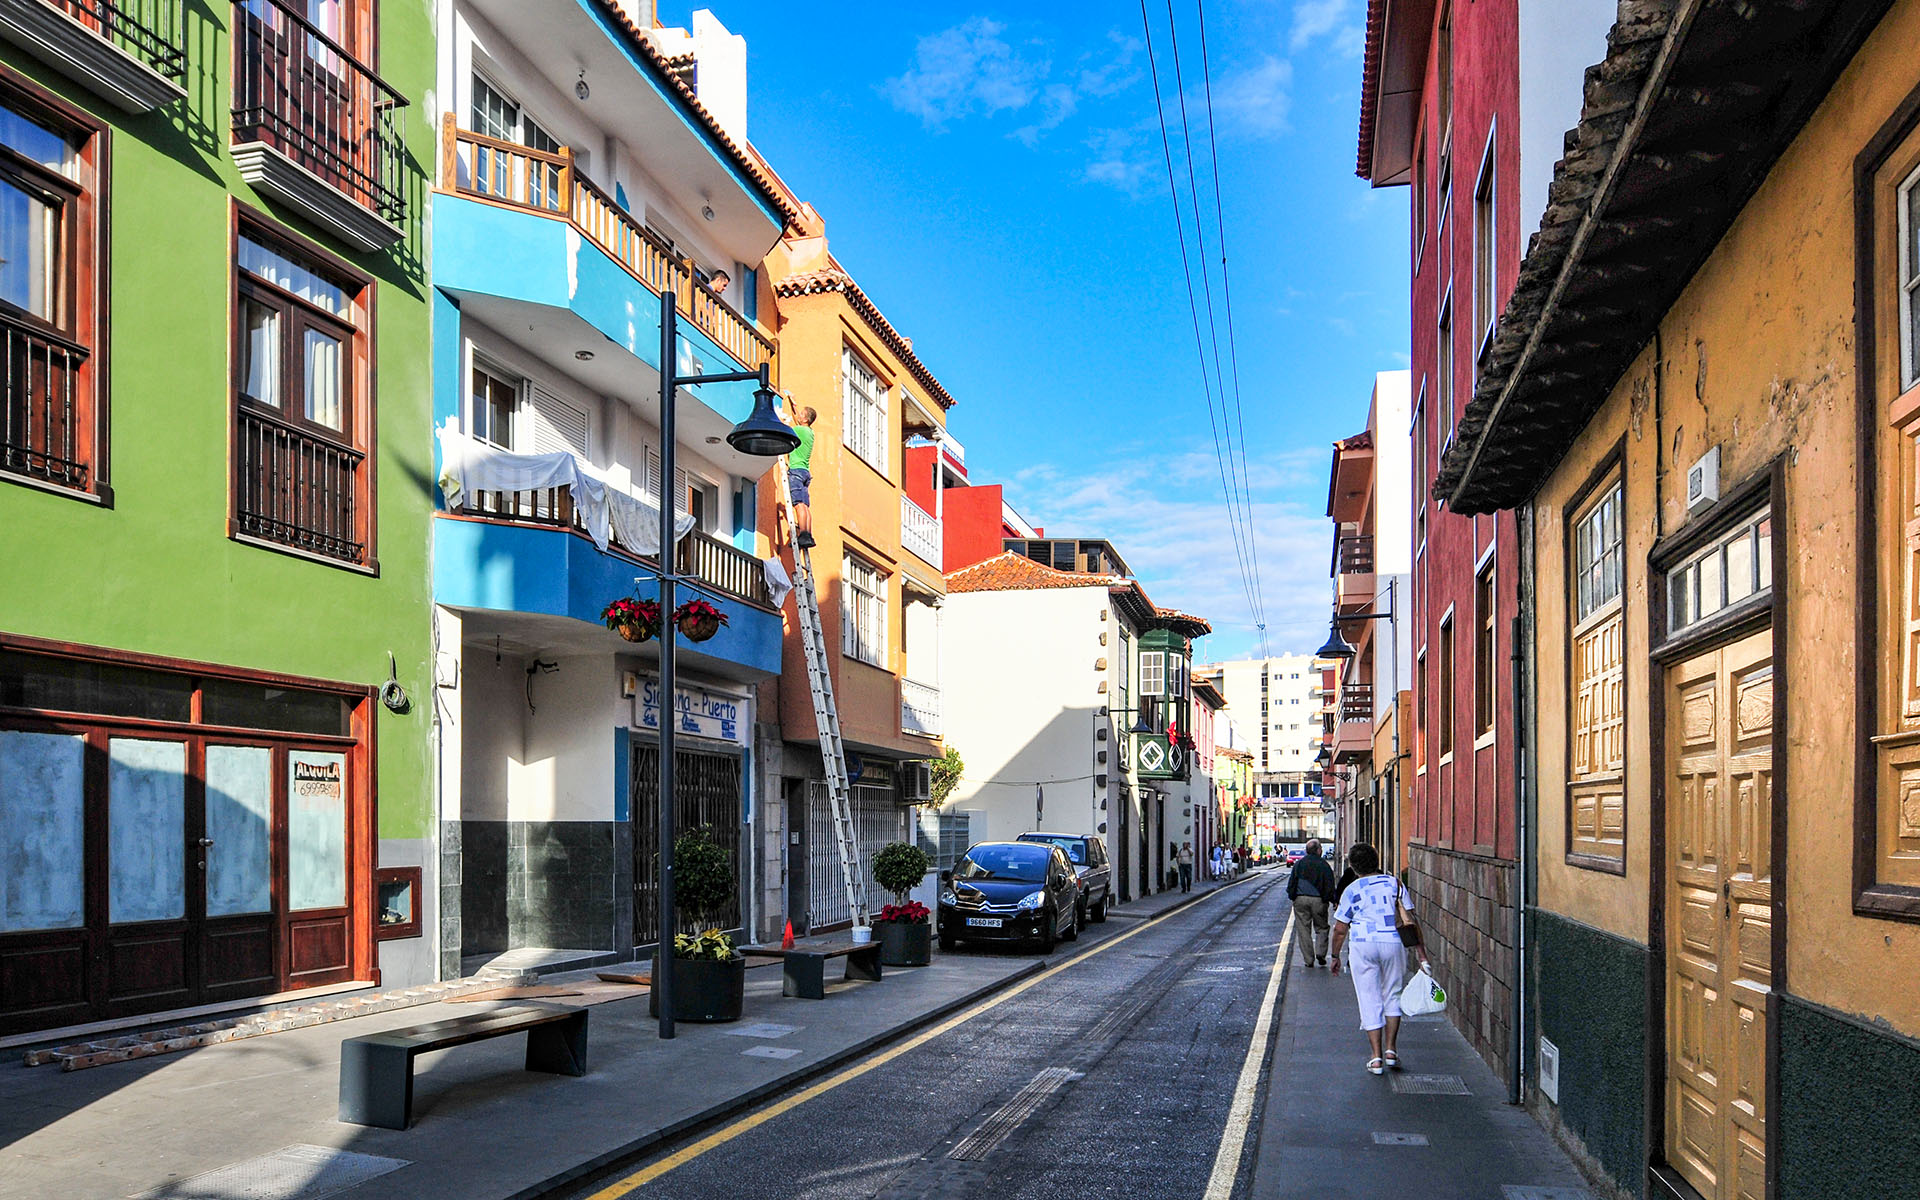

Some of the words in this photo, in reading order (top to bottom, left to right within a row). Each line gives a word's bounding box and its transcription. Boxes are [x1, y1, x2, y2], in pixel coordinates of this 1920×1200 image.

[702, 692, 736, 720] Puerto
[296, 761, 340, 778] ALQUILA
[988, 919, 1001, 927] HFS
